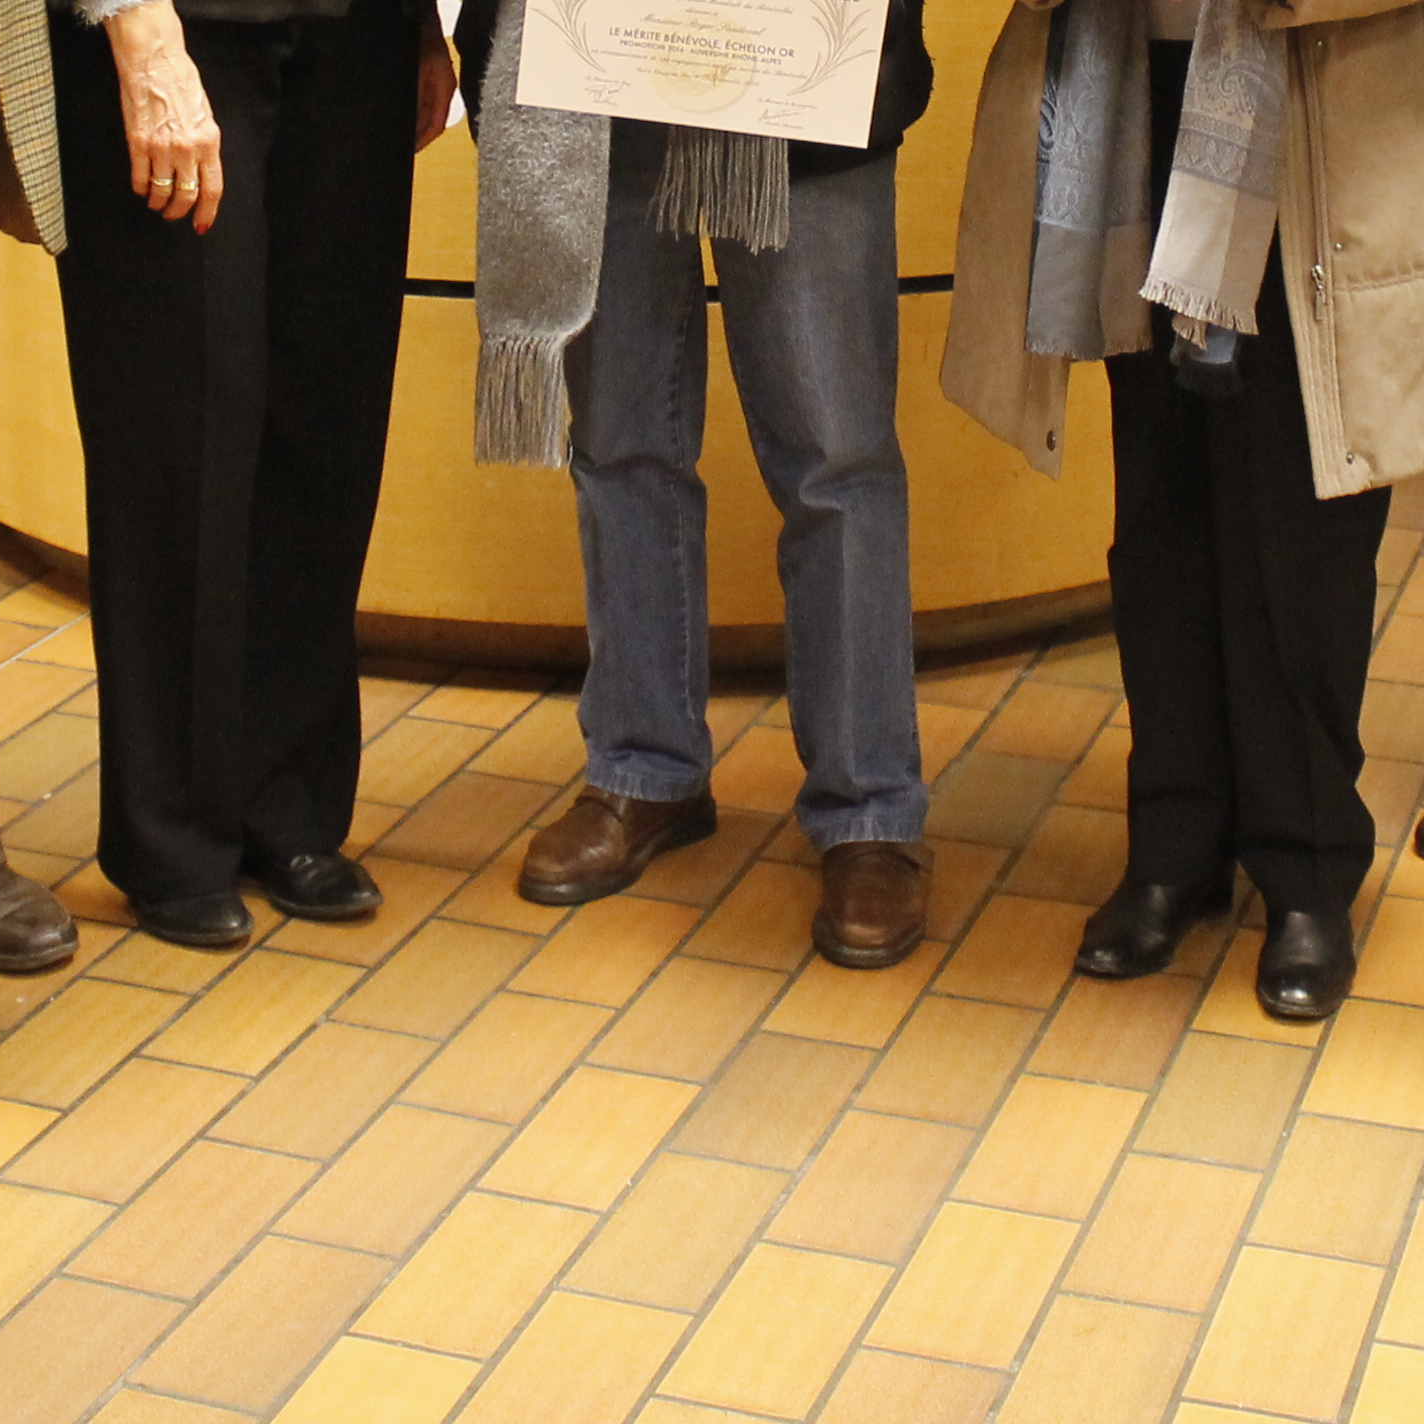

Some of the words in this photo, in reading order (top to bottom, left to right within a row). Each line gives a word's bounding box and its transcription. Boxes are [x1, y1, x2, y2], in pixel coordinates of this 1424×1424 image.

[609, 26, 621, 37] LE
[623, 27, 661, 42] MÉRITE
[663, 31, 722, 51] BÉNÉVOLE,
[779, 47, 795, 59] OR
[619, 39, 666, 52] PROMOTION
[689, 47, 729, 59] AUVERGNE
[761, 56, 782, 65] ALPES
